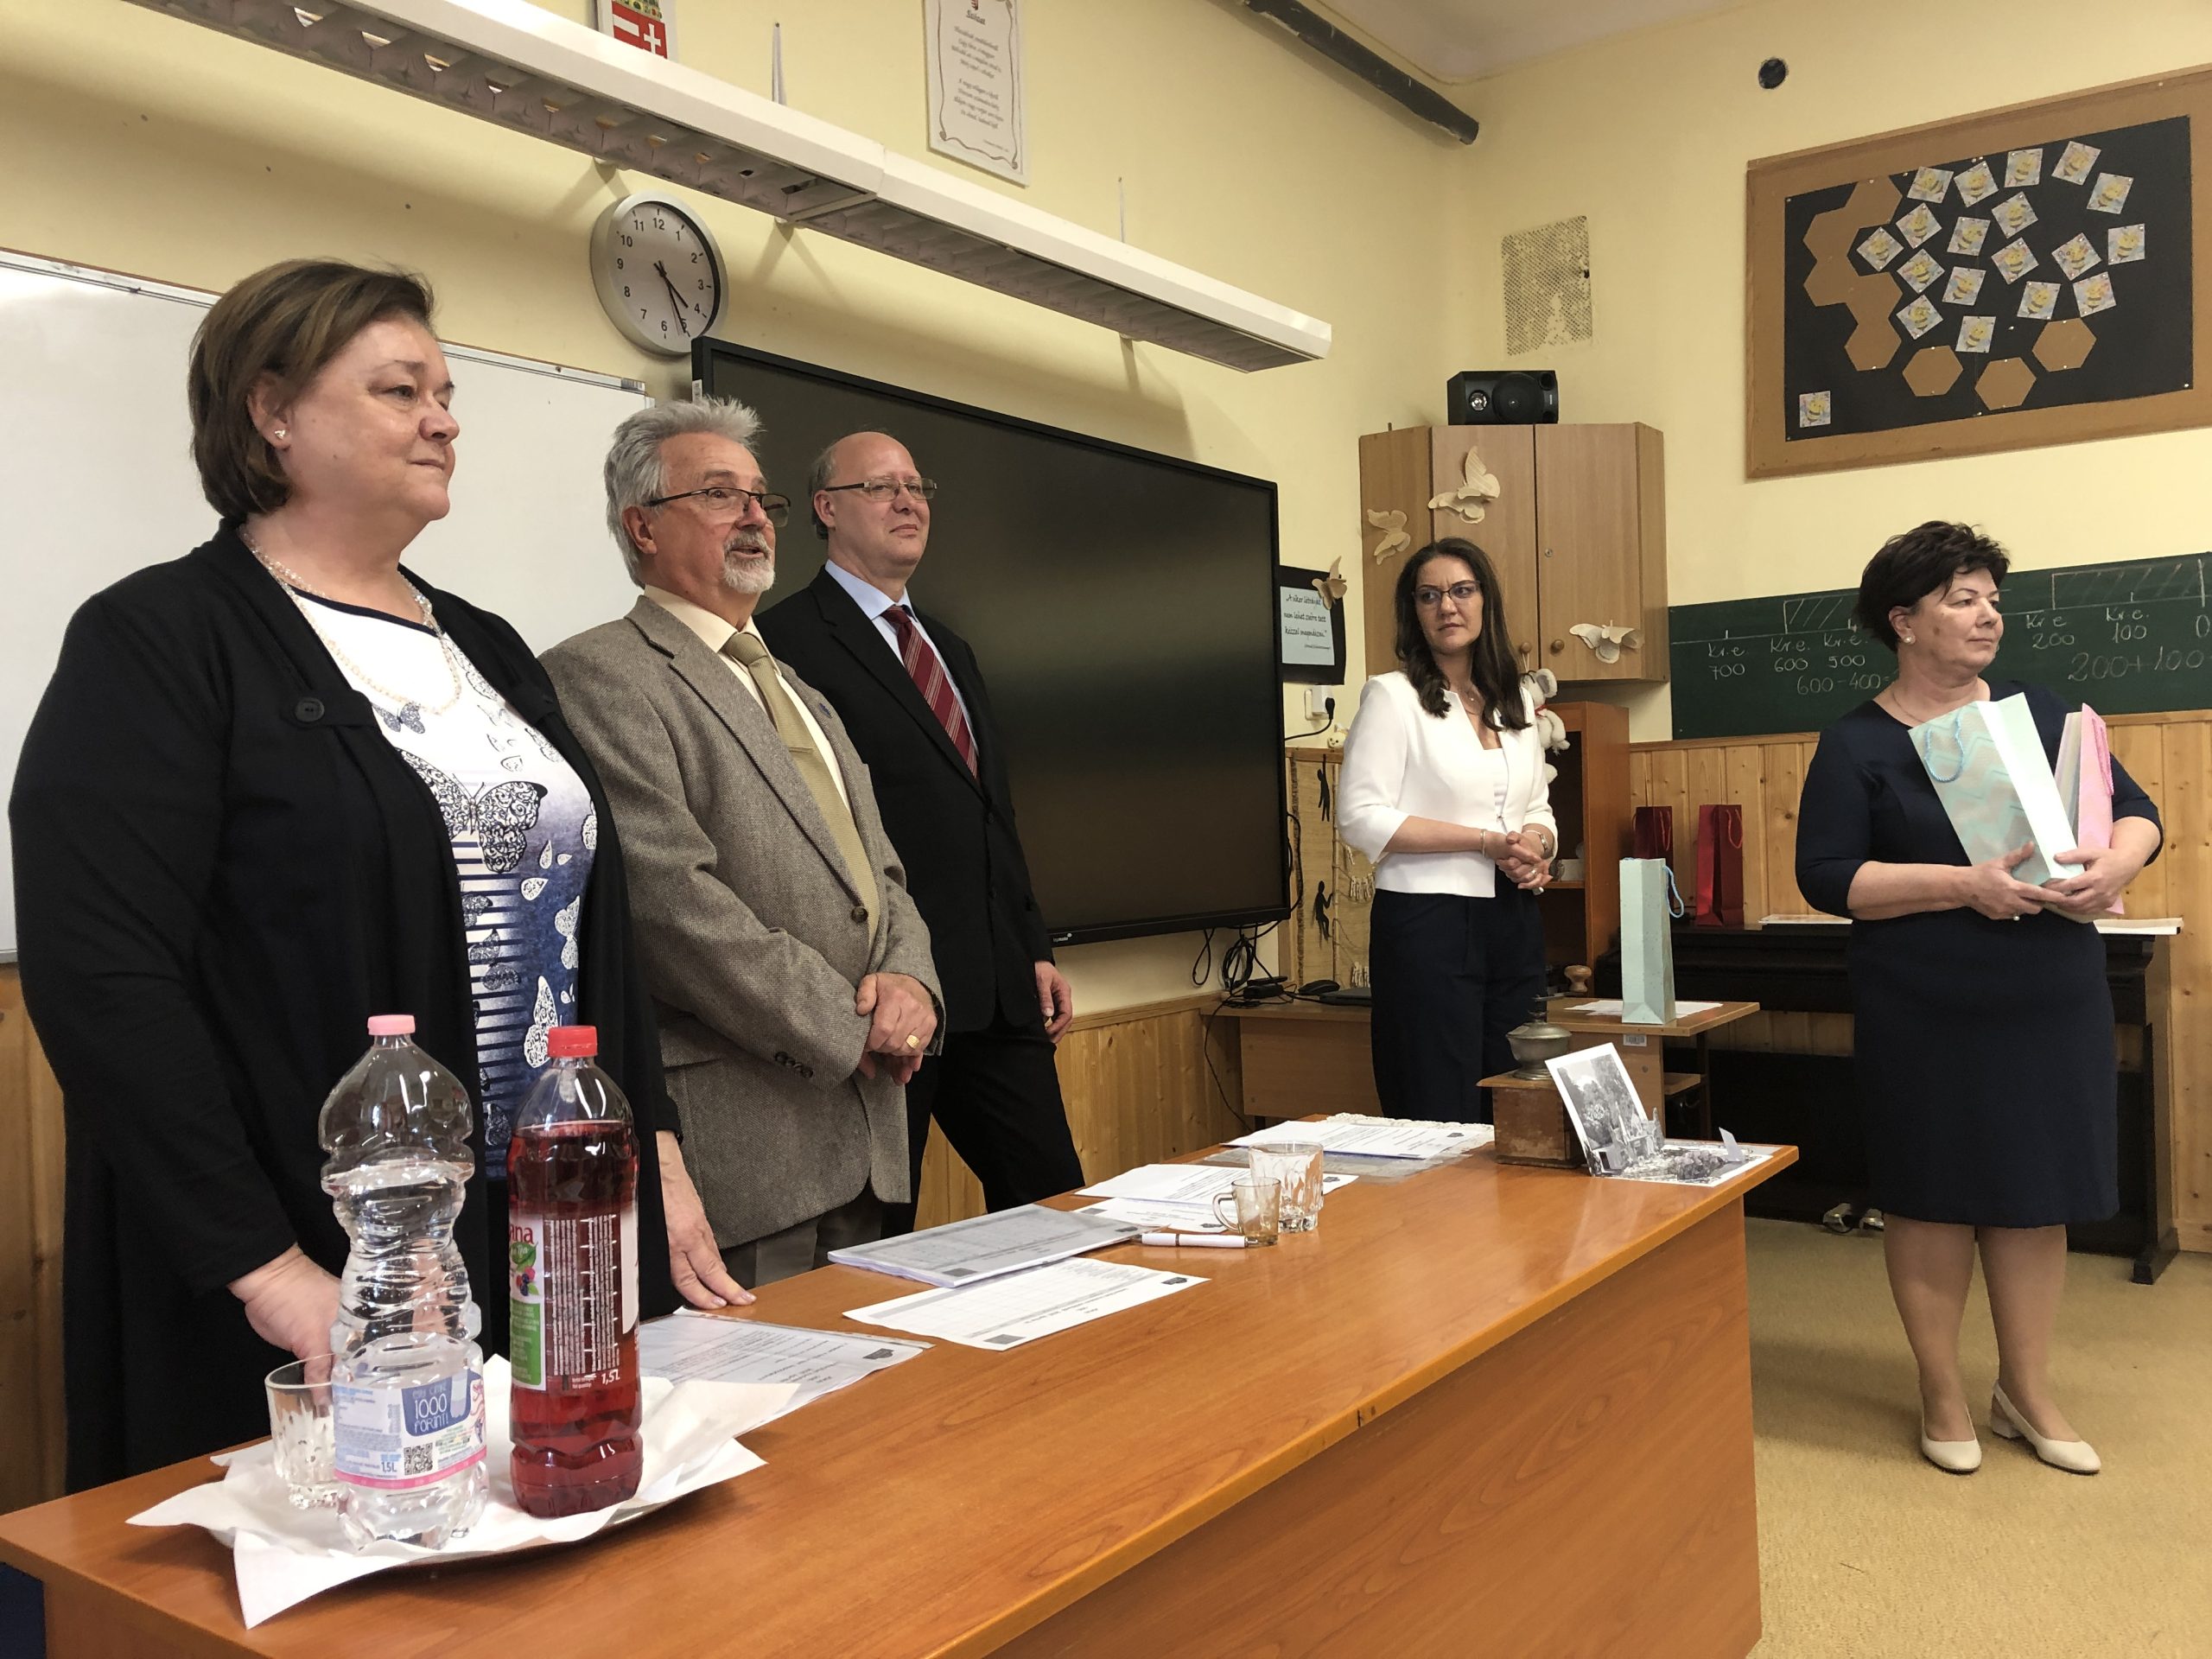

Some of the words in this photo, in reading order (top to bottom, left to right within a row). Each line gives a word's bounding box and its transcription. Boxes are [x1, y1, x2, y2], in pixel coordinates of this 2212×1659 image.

[633, 219, 645, 232] 11
[652, 218, 664, 230] 12
[620, 234, 633, 247] 10
[676, 231, 681, 241] 1
[617, 258, 624, 270] 9
[690, 252, 697, 264] 2
[698, 279, 704, 290] 3
[624, 286, 631, 297] 8
[640, 308, 647, 320] 7
[694, 303, 701, 314] 4
[661, 321, 668, 332] 6
[2113, 622, 2147, 643] 100
[2032, 632, 2074, 650] 200
[1774, 658, 1808, 672] 600
[1828, 655, 1866, 668] 500
[1708, 663, 1745, 680] 700
[601, 1369, 621, 1386] 1,5L
[414, 1393, 448, 1420] 1000
[414, 1418, 449, 1433] FORINT!
